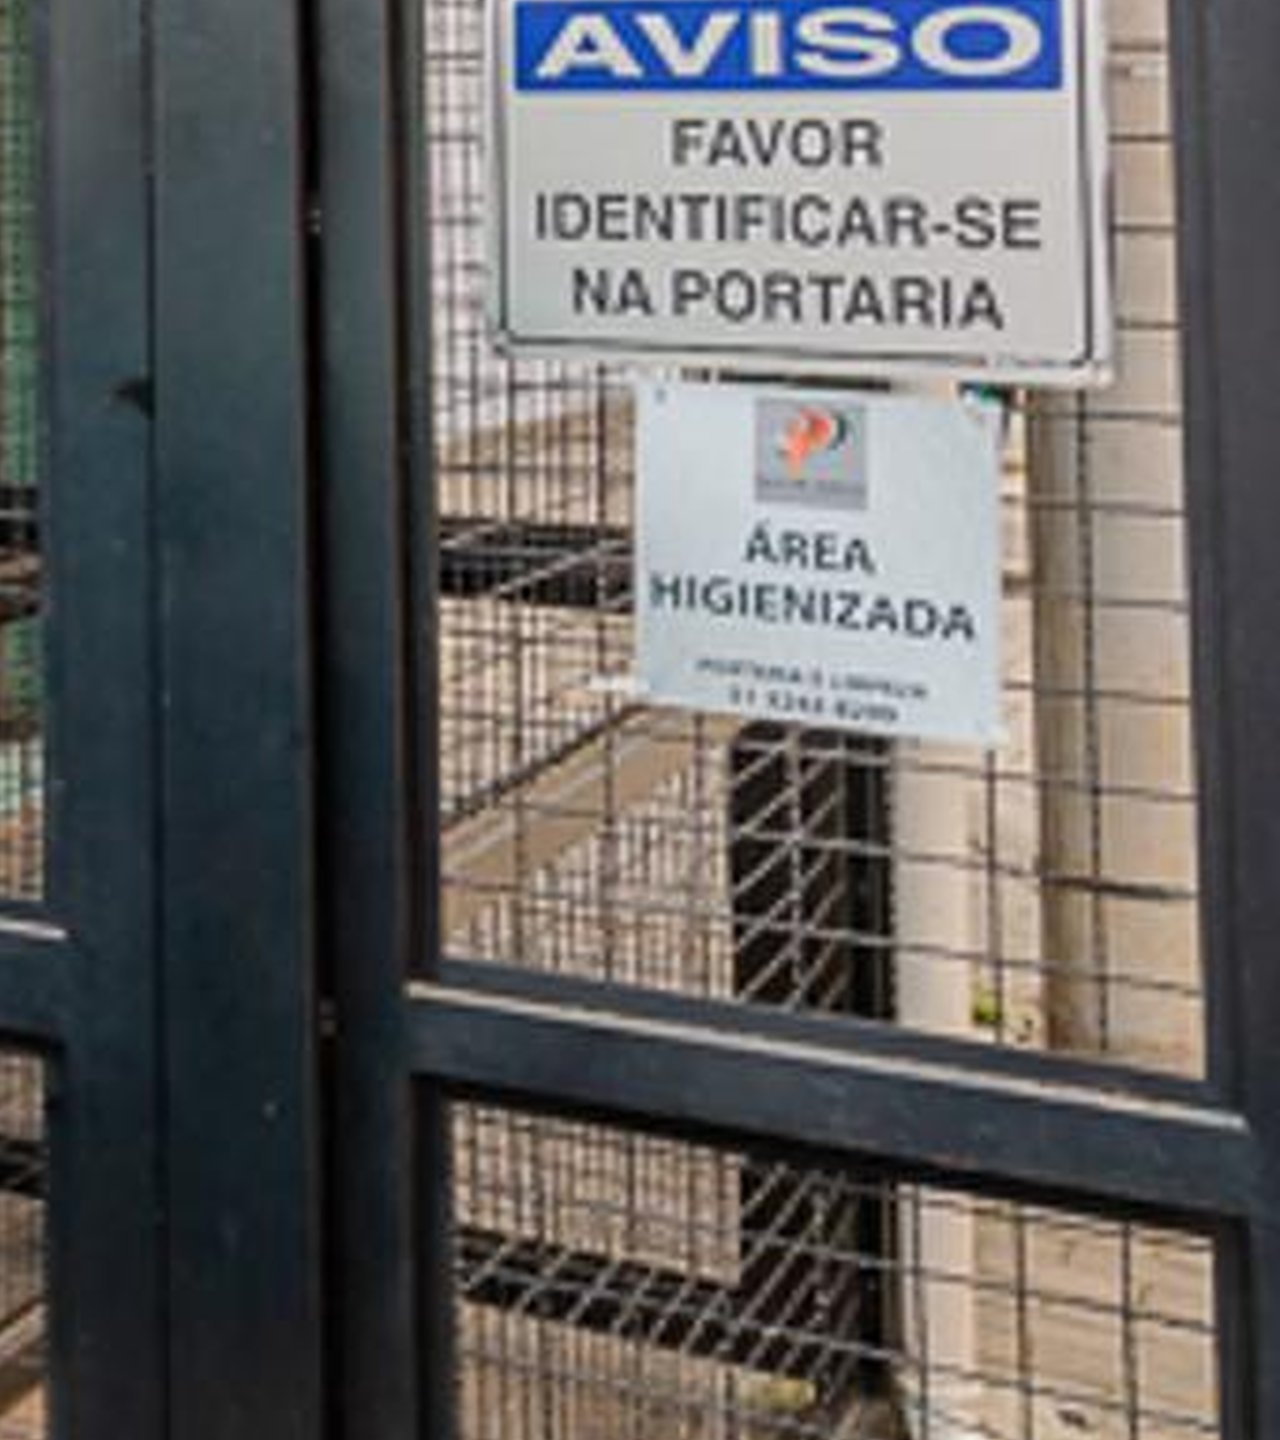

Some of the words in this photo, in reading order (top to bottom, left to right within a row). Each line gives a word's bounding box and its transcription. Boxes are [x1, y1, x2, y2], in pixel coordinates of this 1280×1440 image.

[535, 4, 1043, 80] AVISO
[671, 118, 883, 168] FAVOR
[535, 192, 1042, 250] IDENTIFICAR-SE
[572, 267, 653, 318] NA
[671, 268, 1005, 331] PORTARIA
[744, 518, 877, 576] ÁREA
[649, 572, 977, 642] HIGIENIZADA
